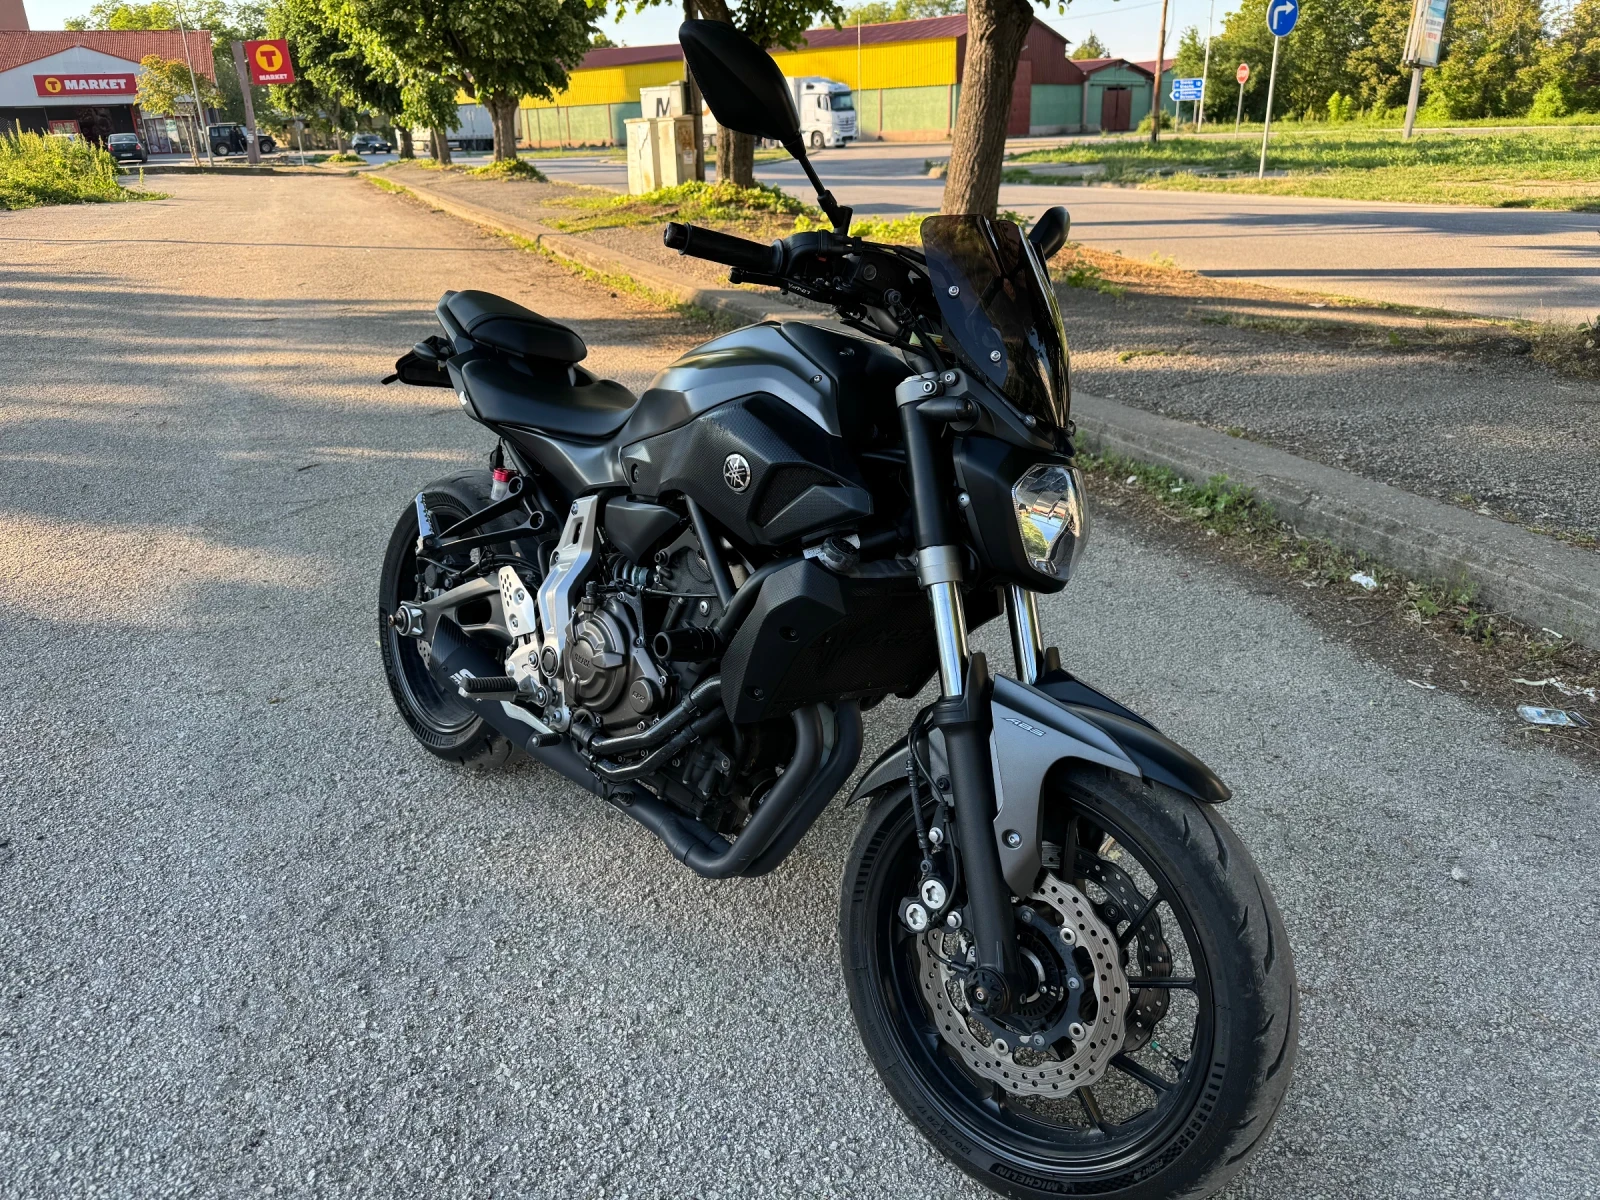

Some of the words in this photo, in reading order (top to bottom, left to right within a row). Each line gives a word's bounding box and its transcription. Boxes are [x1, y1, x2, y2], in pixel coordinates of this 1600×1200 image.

[63, 79, 127, 90] MARKET
[258, 73, 288, 81] MARKET
[1000, 717, 1046, 737] ABS
[916, 1105, 928, 1116] 17
[926, 1114, 941, 1128] ZR
[938, 1127, 972, 1156] 120/70
[1142, 1159, 1163, 1176] FRONT
[995, 1165, 1063, 1192] MICHELIN
